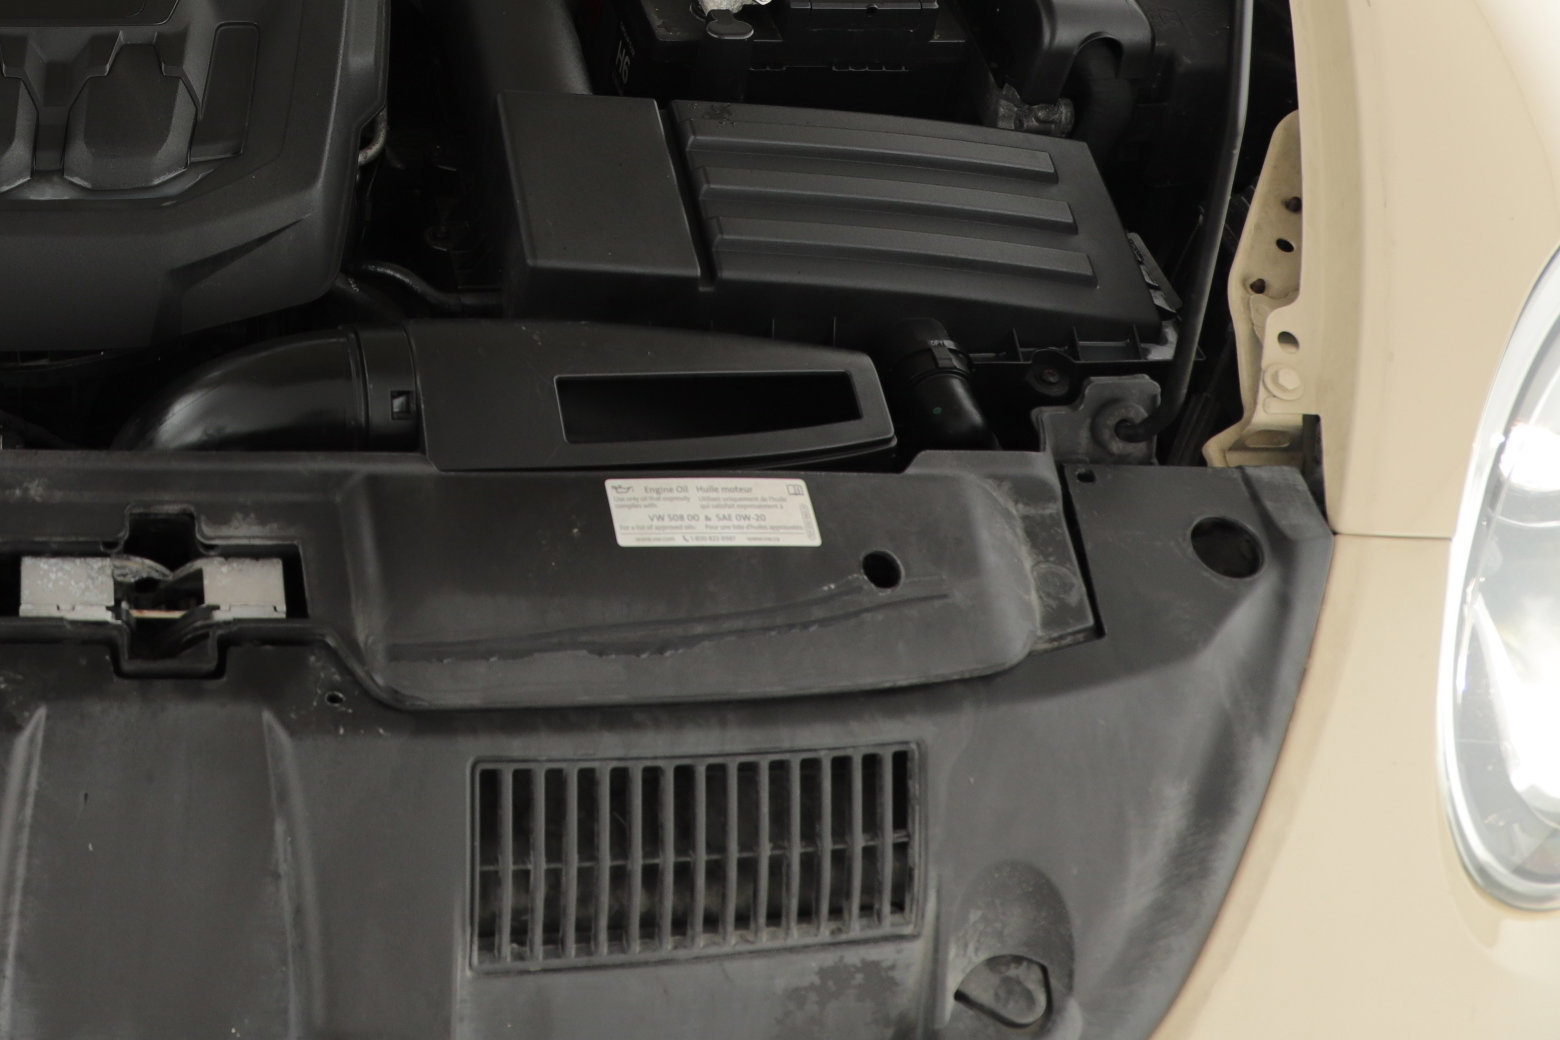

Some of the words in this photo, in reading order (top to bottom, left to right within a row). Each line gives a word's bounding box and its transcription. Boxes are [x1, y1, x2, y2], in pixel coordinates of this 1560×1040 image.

[615, 39, 631, 85] H6
[643, 485, 675, 494] Engine
[676, 485, 689, 493] Oil
[696, 485, 719, 493] Huile
[721, 486, 753, 494] moteur
[648, 513, 665, 522] VW
[667, 513, 684, 522] 508
[686, 513, 700, 522] 00
[716, 513, 733, 522] SAE
[735, 513, 767, 522] 0W-20
